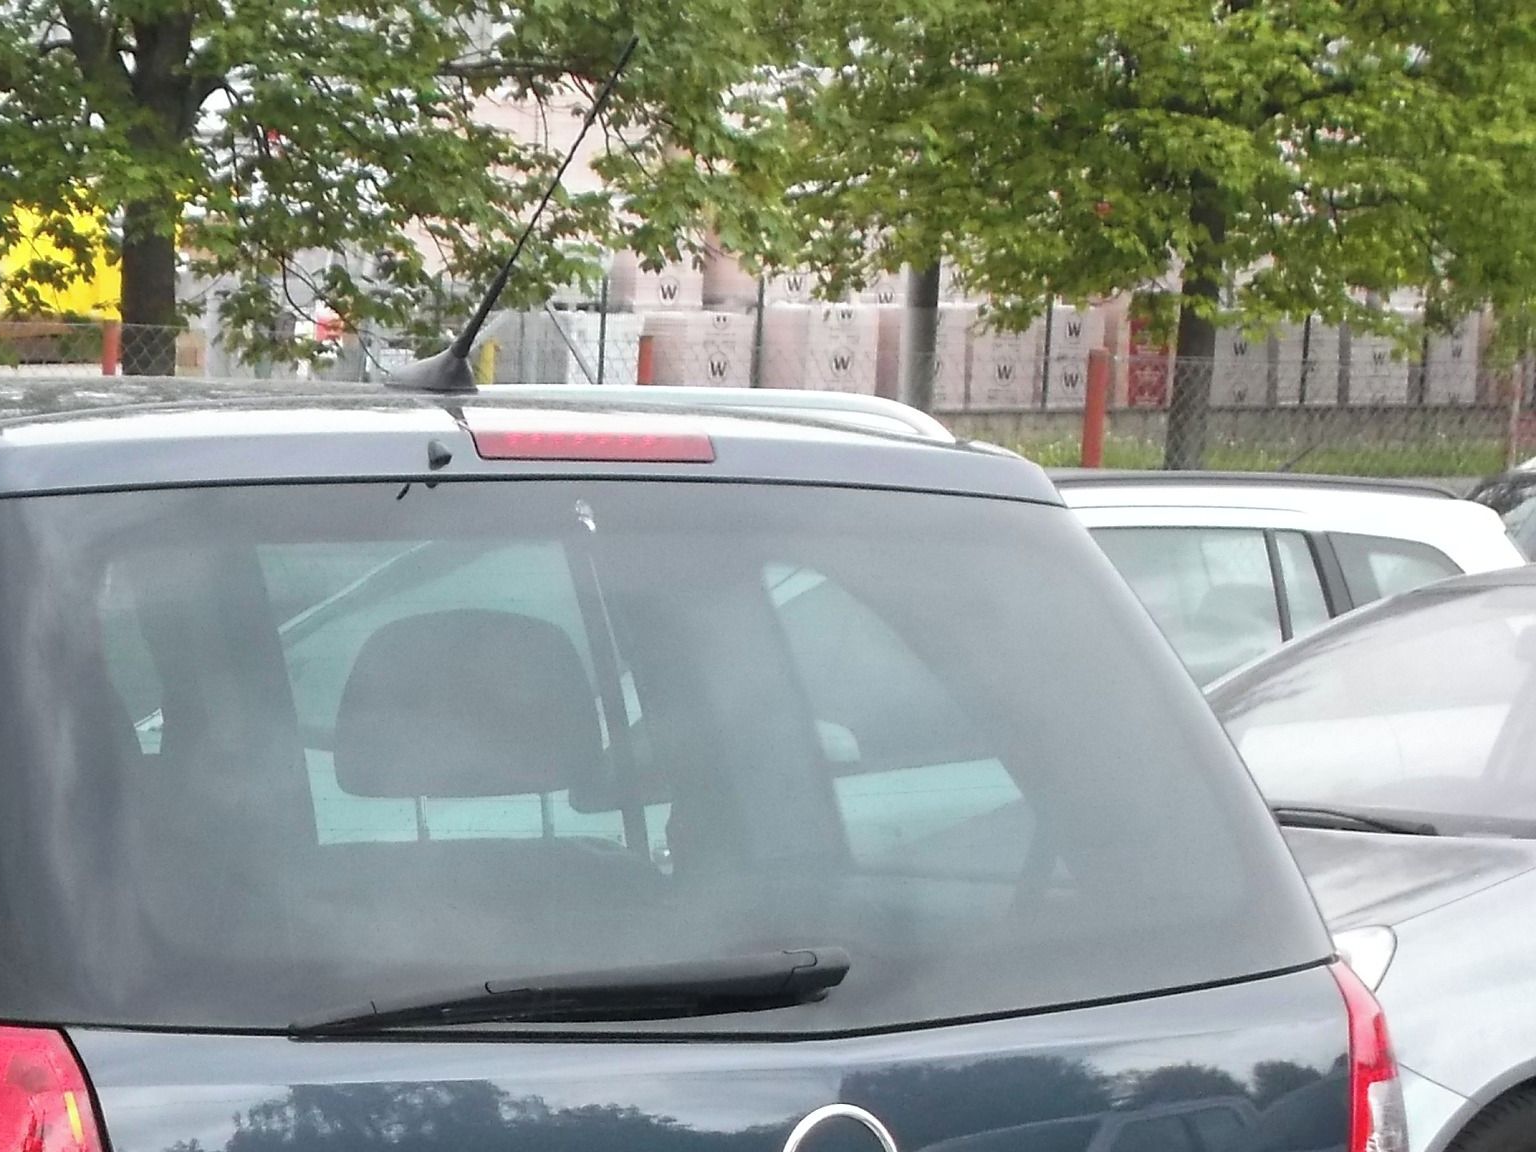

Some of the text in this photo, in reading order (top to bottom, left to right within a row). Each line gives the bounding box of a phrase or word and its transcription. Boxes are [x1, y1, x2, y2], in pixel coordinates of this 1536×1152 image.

[660, 284, 678, 300] W
[786, 276, 803, 292] W
[878, 292, 895, 304] W
[1066, 321, 1082, 338] W
[1233, 342, 1248, 356] W
[710, 360, 728, 377] W
[833, 356, 851, 371] W
[997, 363, 1013, 380] W
[1063, 372, 1080, 389] W
